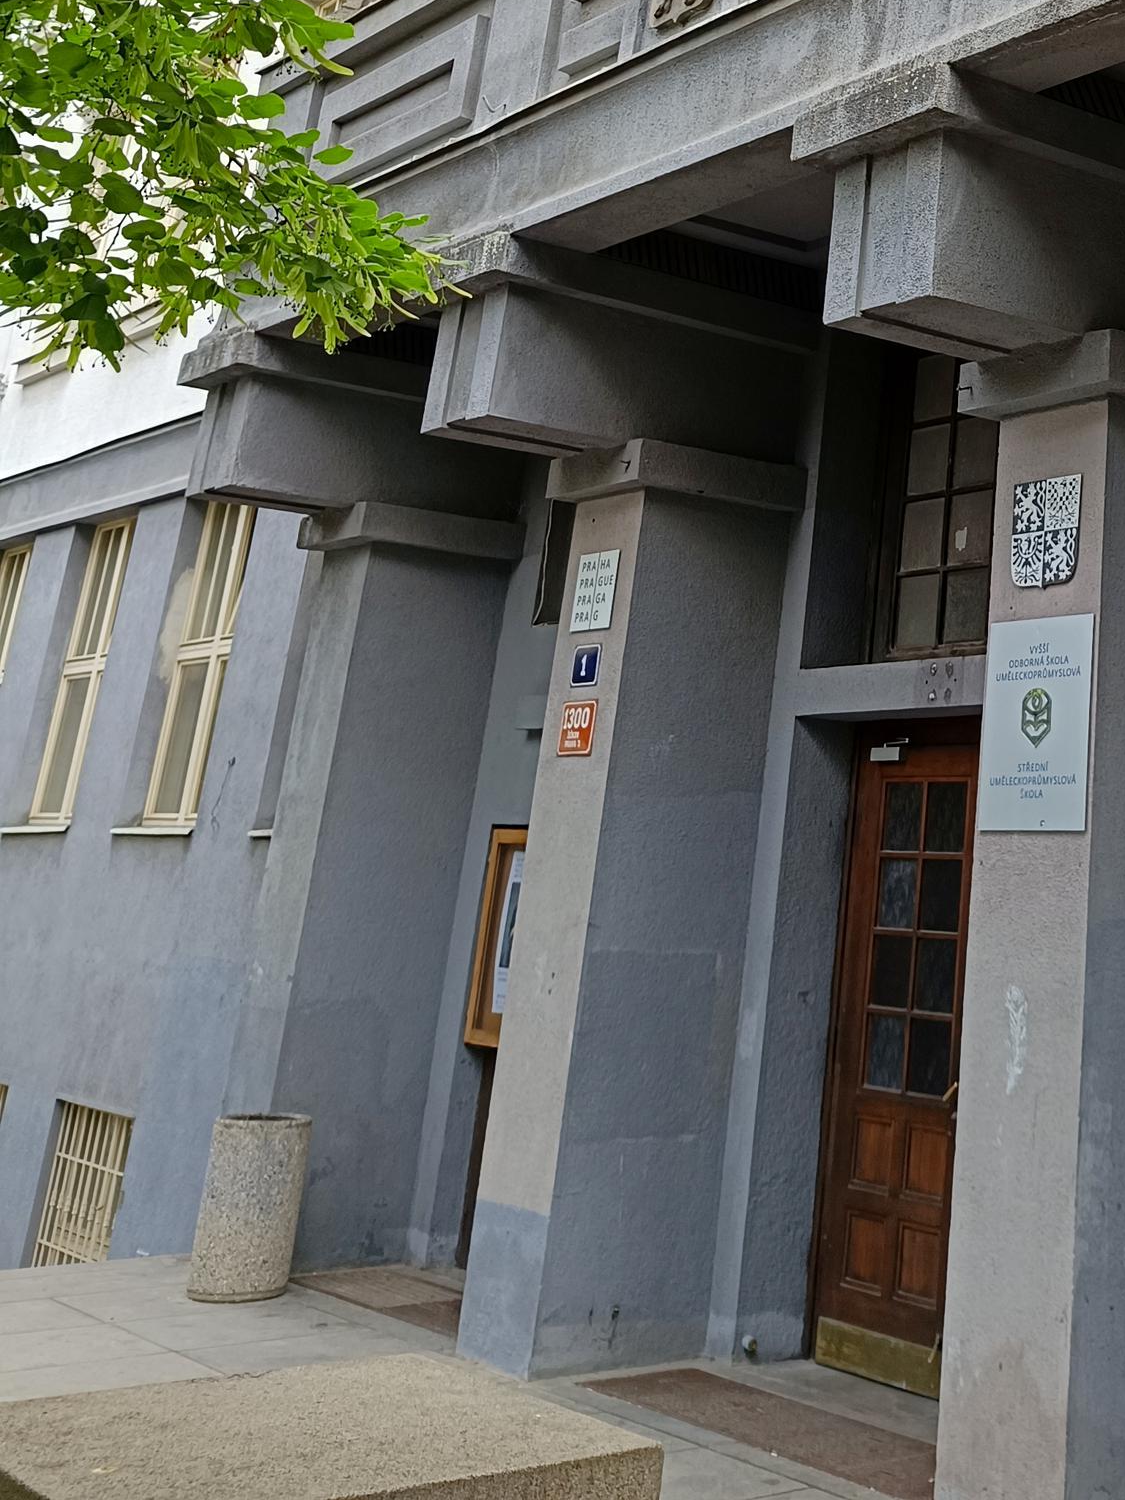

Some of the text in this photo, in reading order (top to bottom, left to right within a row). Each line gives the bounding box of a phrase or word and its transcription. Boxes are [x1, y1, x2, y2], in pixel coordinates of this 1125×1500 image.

[1029, 642, 1050, 655] VYŠŠÍ
[579, 654, 588, 677] 1
[1008, 655, 1069, 669] ODBORNÁ ŠKOLA
[995, 665, 1081, 682] UMĚLECKOPRŮMYSLOVÁ
[563, 706, 591, 730] 1300
[1017, 761, 1049, 773] STŘEDNÍ
[989, 773, 1077, 787] UMĚLECKOPRŮMYSLOVÁ
[1019, 788, 1044, 799] ŠKOLA
